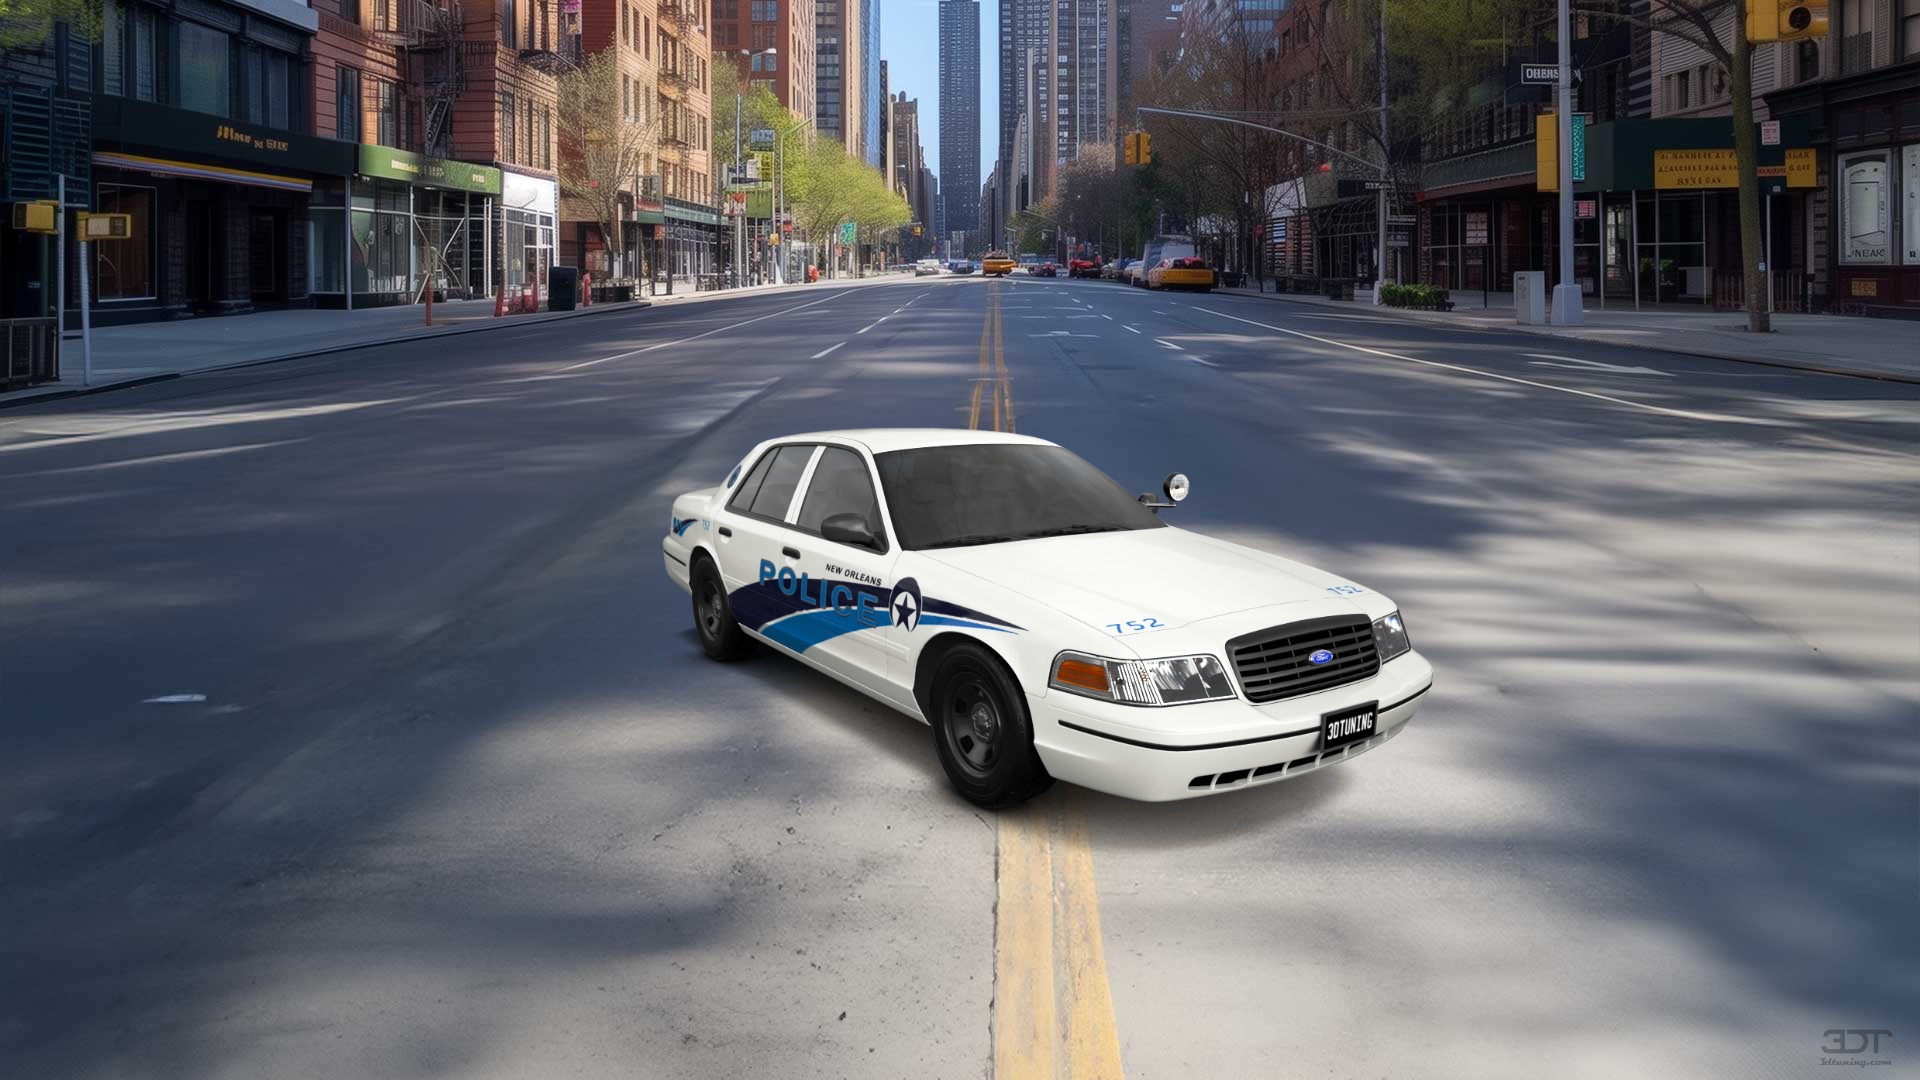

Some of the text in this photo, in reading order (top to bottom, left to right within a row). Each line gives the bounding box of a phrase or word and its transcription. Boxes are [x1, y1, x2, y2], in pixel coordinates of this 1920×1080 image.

[825, 563, 883, 587] NEW ORLEANS
[758, 558, 880, 629] POLICE
[1327, 585, 1364, 596] 752
[1106, 617, 1165, 635] 752
[1326, 711, 1374, 741] 3DTUNING
